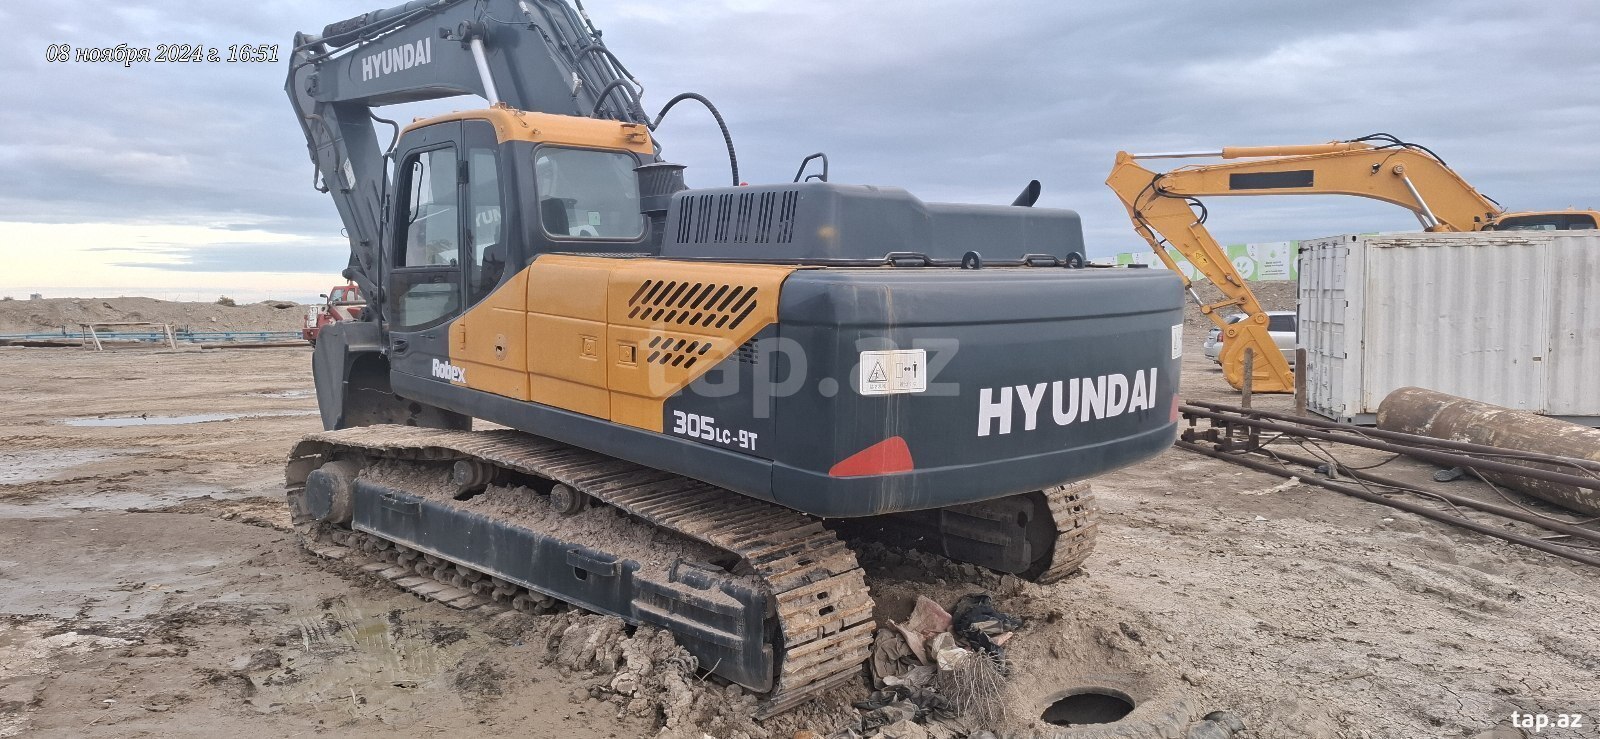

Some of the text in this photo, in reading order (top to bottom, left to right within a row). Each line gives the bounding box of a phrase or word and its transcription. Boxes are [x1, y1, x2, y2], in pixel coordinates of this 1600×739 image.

[361, 36, 432, 82] HYUNDAI
[432, 358, 467, 384] Robex
[977, 367, 1158, 437] HYUNDAI
